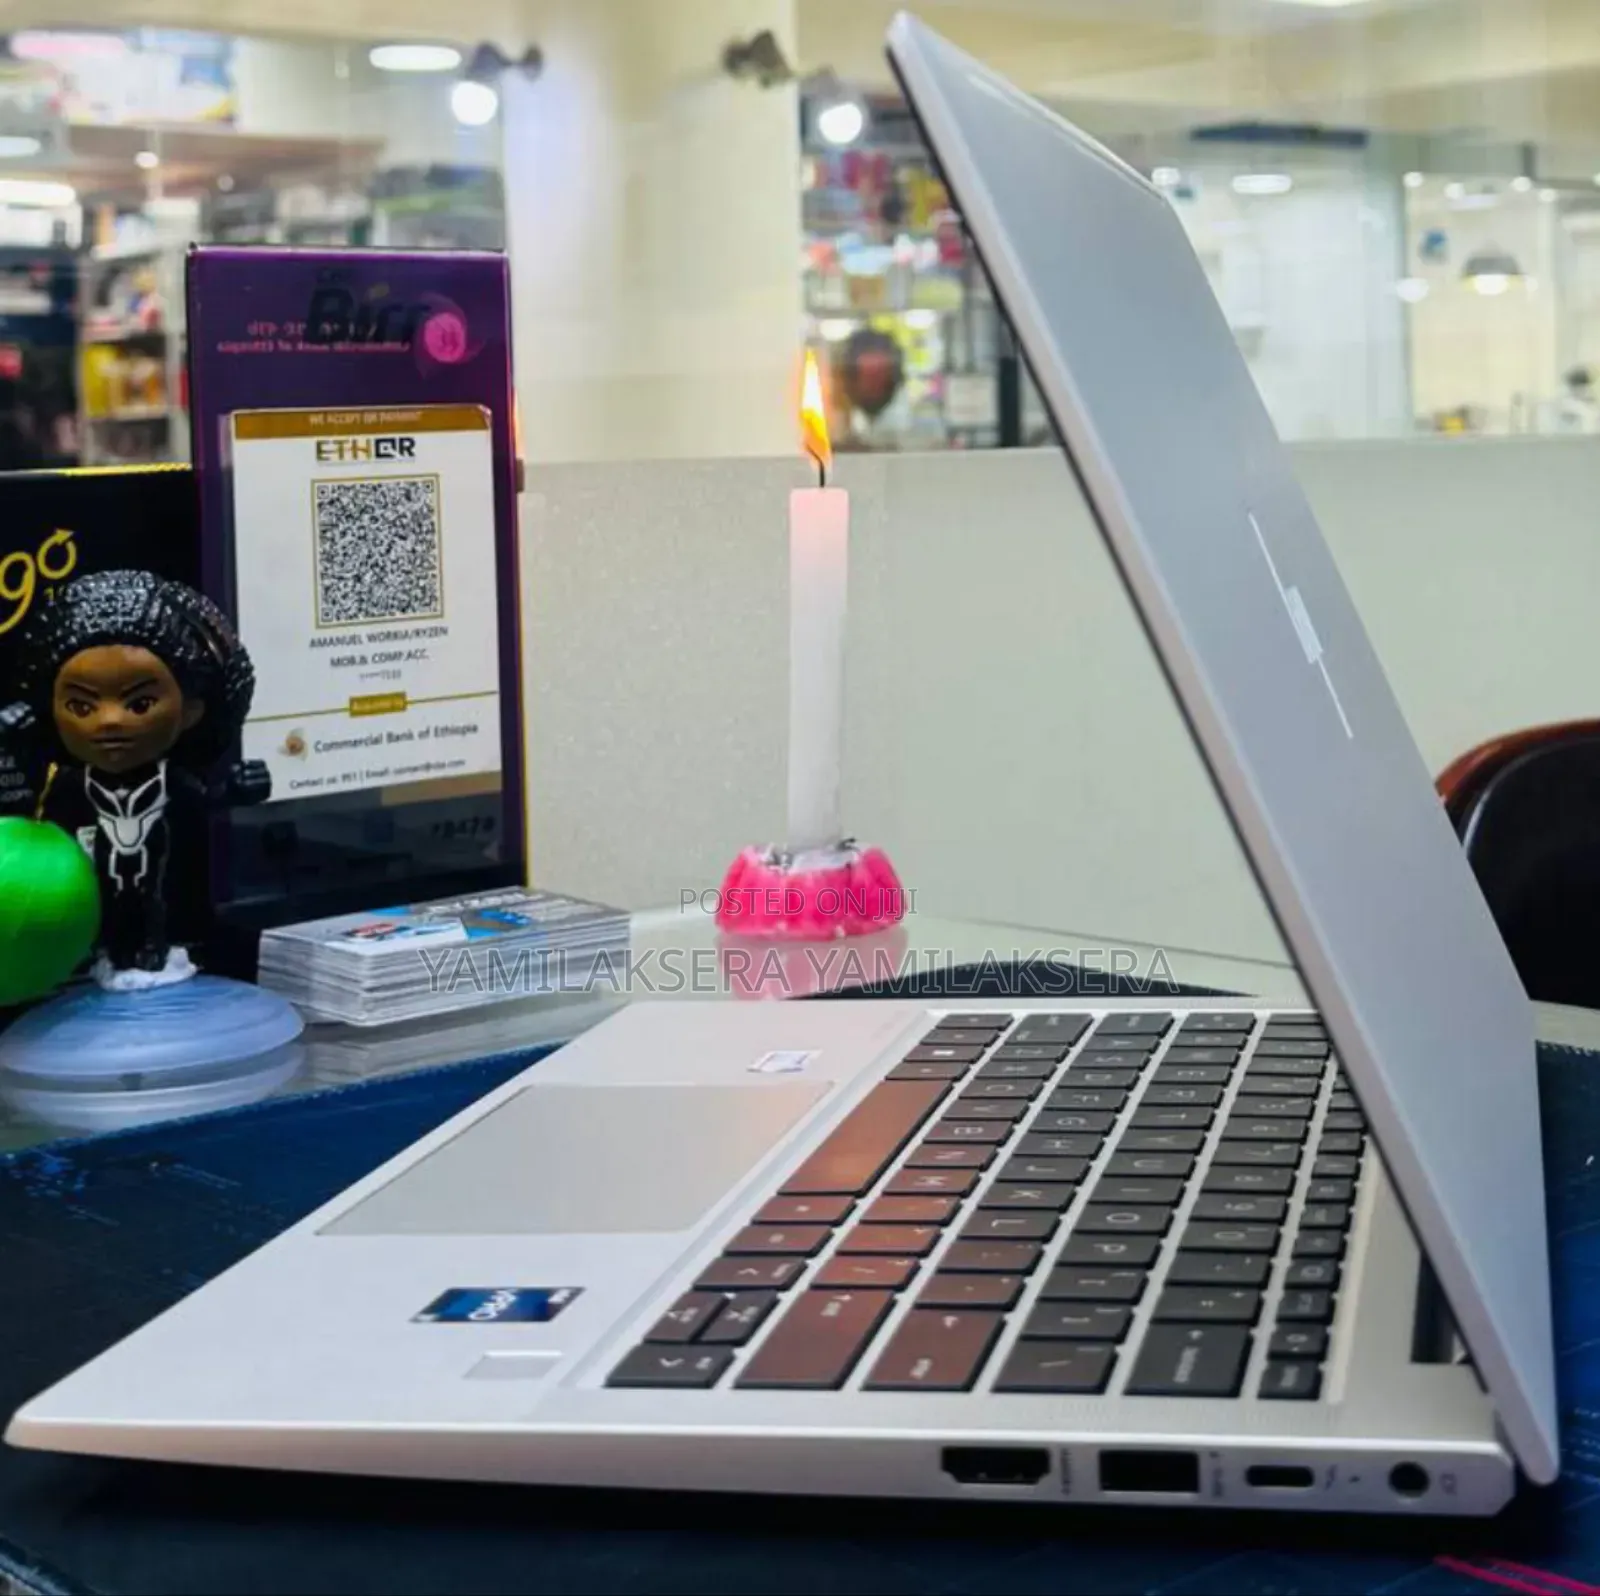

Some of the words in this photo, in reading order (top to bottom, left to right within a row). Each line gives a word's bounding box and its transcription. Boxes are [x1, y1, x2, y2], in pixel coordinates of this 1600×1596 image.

[309, 635, 363, 648] AMANUEL
[313, 734, 383, 753] Commercial
[386, 730, 414, 743] Bank
[418, 725, 431, 738] of
[434, 722, 479, 739] Ethiopia
